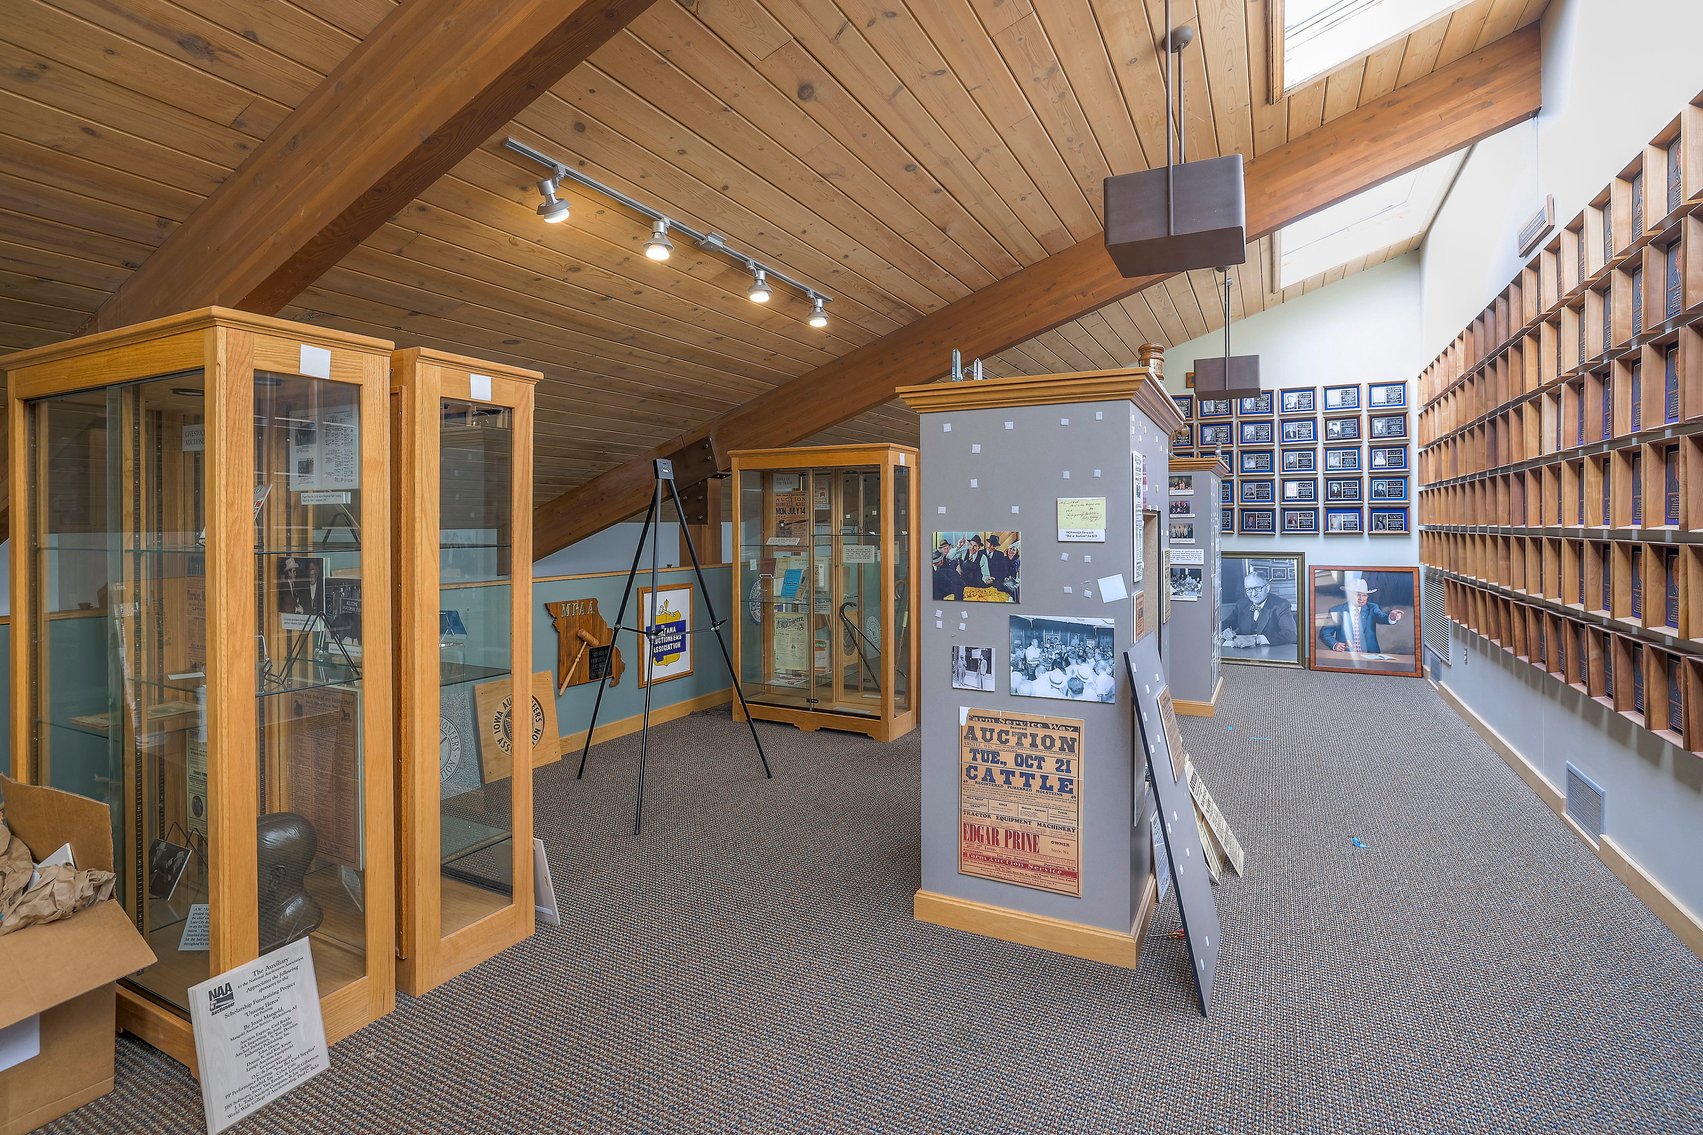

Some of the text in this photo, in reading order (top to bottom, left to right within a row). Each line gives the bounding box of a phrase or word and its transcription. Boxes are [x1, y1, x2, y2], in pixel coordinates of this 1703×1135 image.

[561, 600, 593, 617] MPAA
[655, 634, 682, 644] UCTIONEERS
[494, 710, 504, 734] IOWA
[999, 717, 1043, 728] Service
[964, 726, 1077, 753] AUCTION
[1014, 753, 1045, 770] OCT
[1055, 758, 1071, 773] 21
[966, 765, 1074, 794] CATTLE
[963, 811, 1076, 833] TRACTOR EQUIPMENT MACHINERY
[963, 823, 1040, 853] EDGAR PRINE
[1028, 864, 1063, 874] Service
[266, 959, 288, 971] Auxiliary
[247, 979, 271, 992] Appreciates
[280, 966, 298, 978] following
[250, 974, 264, 983] National
[259, 982, 276, 992] sponsors
[209, 983, 232, 1001] NAA
[225, 982, 295, 1018] Scholarship Fundraising Project
[212, 1002, 234, 1016] Auctioneer
[246, 1026, 259, 1034] Auction
